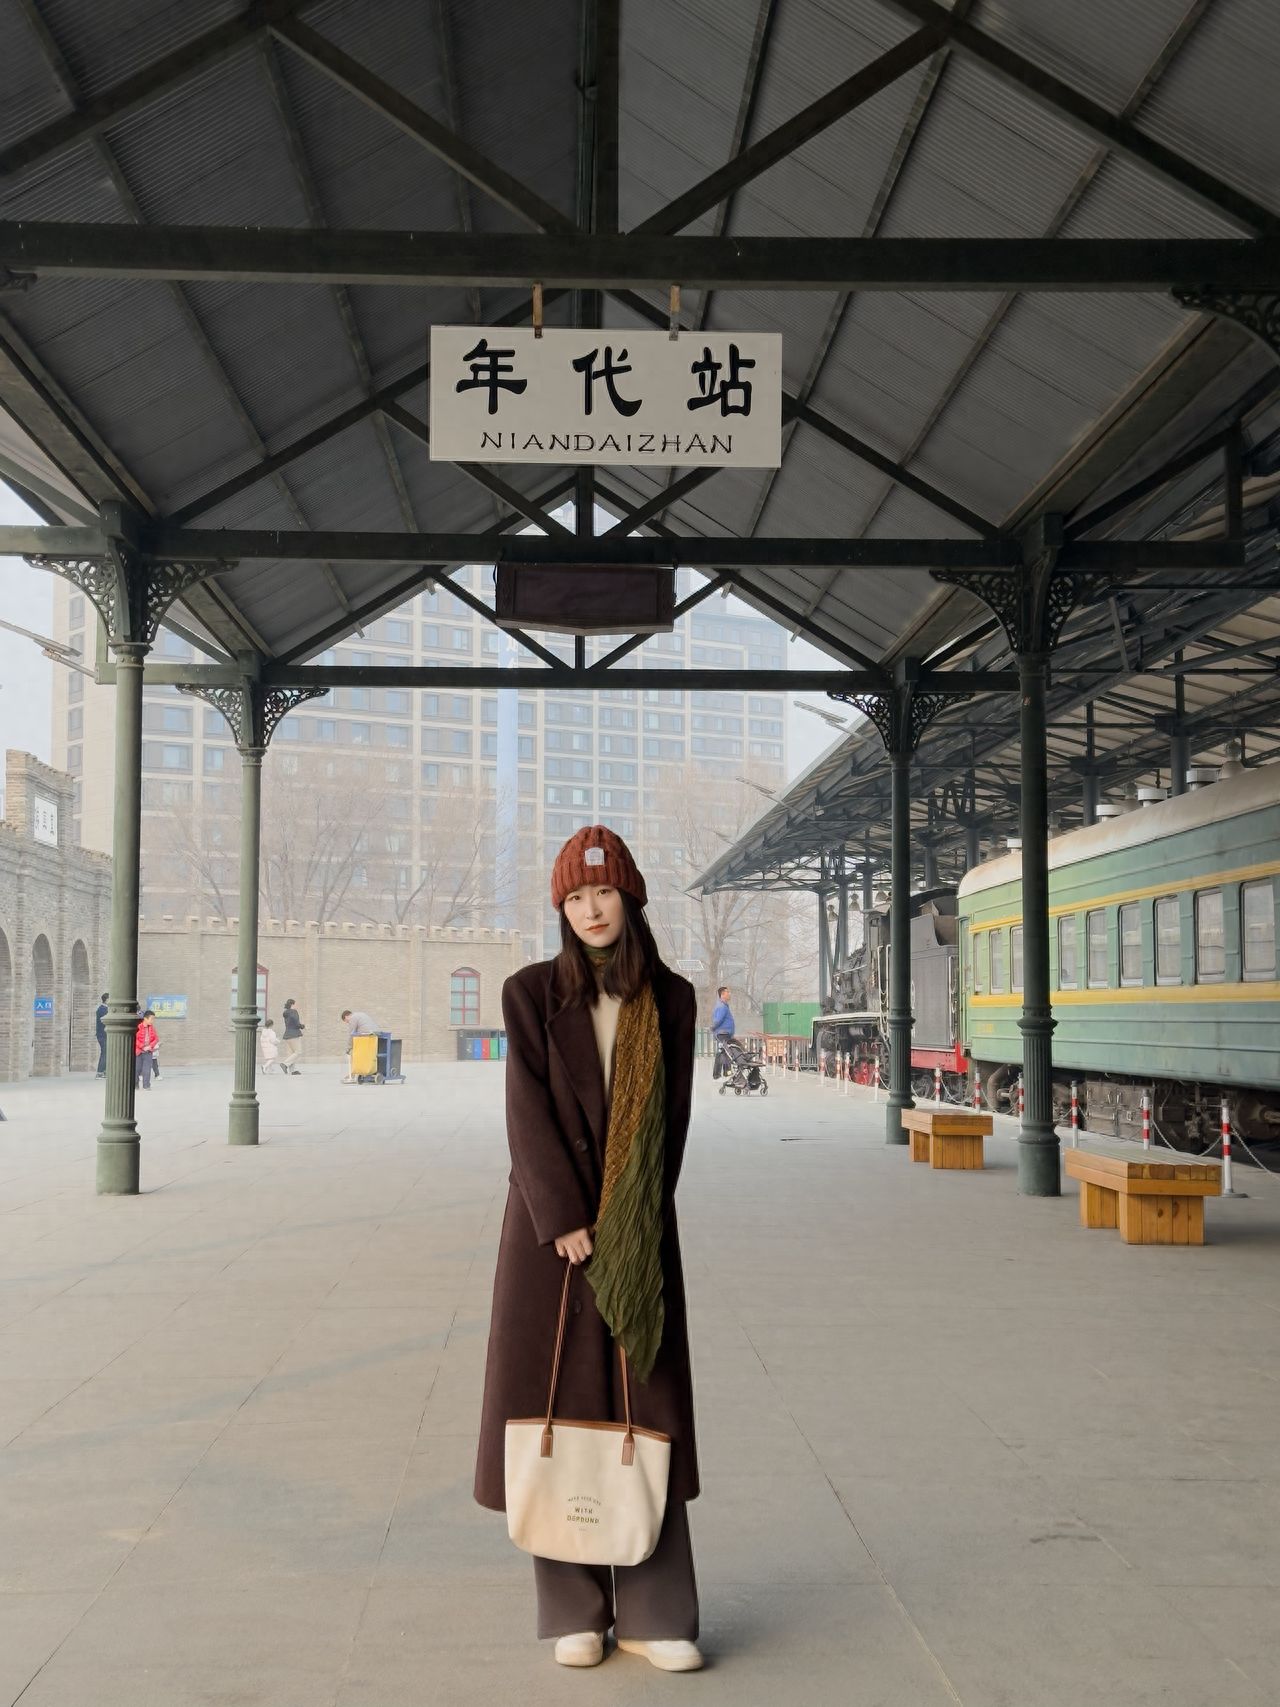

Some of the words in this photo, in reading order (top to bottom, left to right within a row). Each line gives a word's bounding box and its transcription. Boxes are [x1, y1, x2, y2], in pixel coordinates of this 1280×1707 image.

[456, 338, 756, 418] 年代站
[481, 432, 734, 455] NIANDAIZHAN
